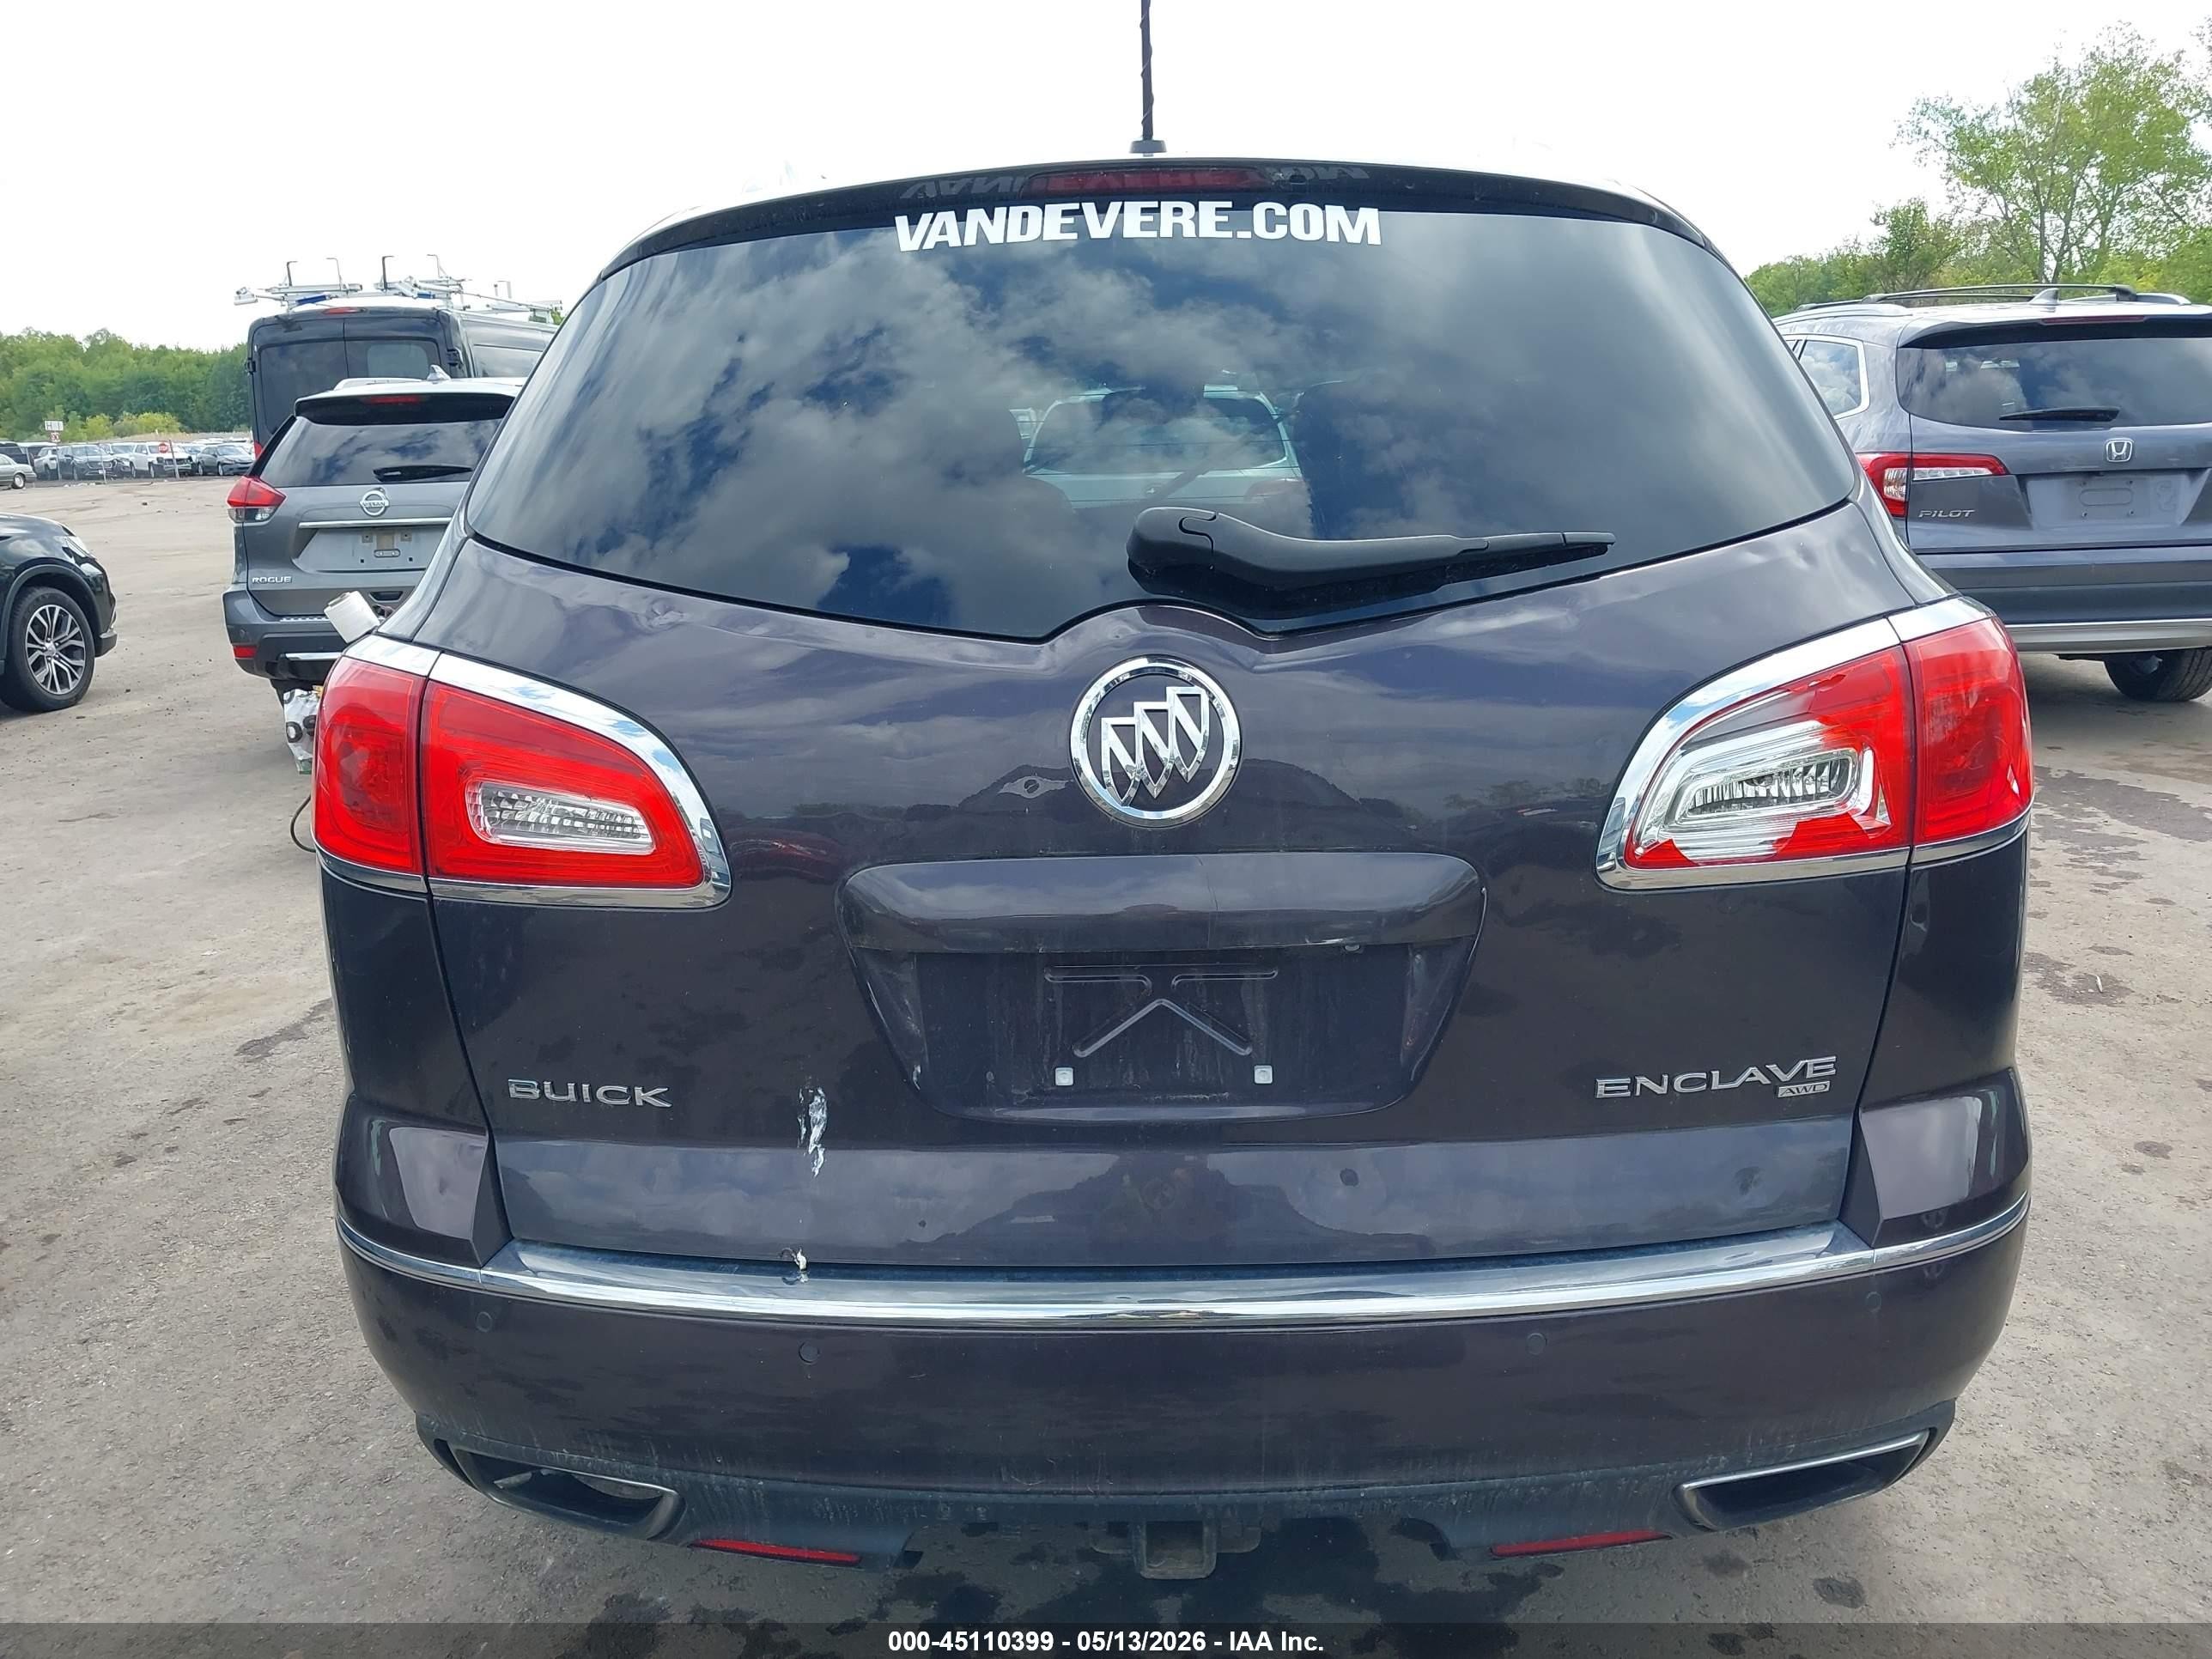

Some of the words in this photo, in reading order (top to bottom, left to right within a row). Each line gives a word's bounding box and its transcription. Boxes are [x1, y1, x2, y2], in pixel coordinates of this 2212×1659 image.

[894, 200, 1382, 252] VANDEVERE.COM
[1918, 509, 1975, 518] PILOT
[252, 575, 292, 584] ROGUE
[1596, 1056, 1837, 1098] ENCLAVE
[507, 1079, 673, 1108] BUICK
[1779, 1081, 1830, 1097] AWD
